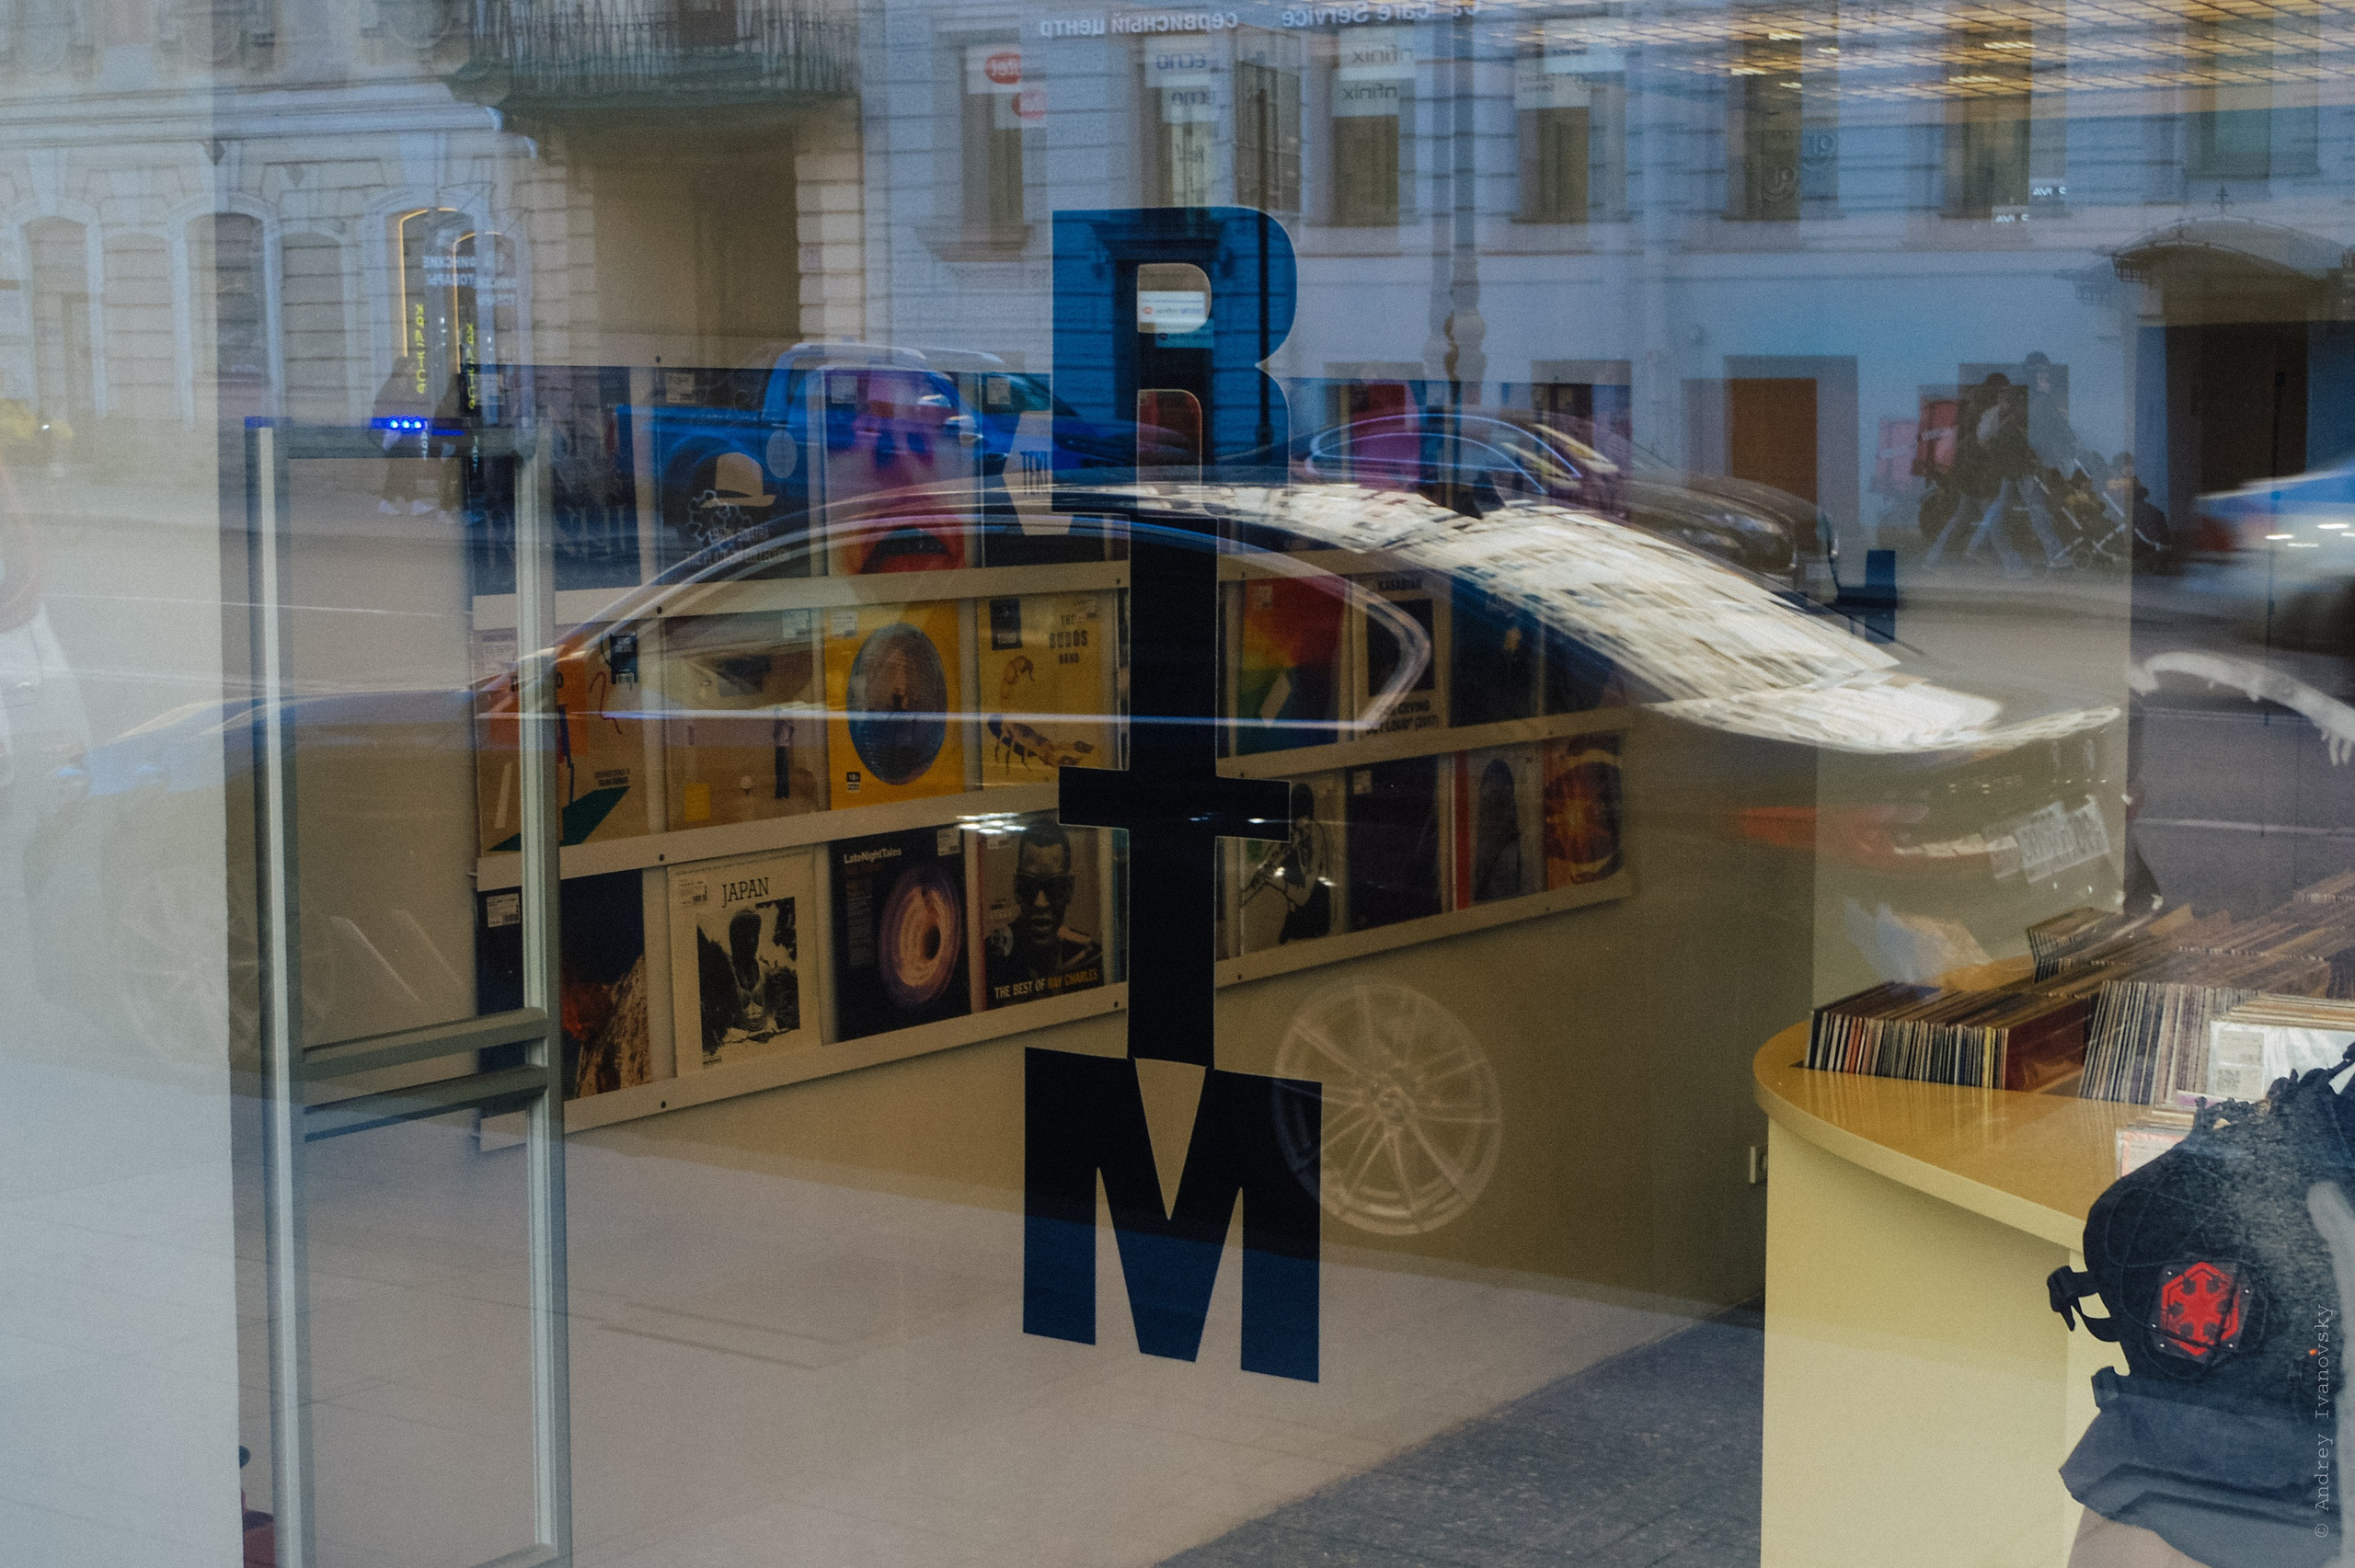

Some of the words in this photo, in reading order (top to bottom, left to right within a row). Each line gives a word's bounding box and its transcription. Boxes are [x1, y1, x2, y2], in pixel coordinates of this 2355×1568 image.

[844, 848, 902, 864] LateNightTales
[722, 876, 769, 907] JAPAN
[994, 986, 1010, 999] THE
[1013, 981, 1032, 995] BEST
[1035, 979, 1046, 991] OF
[1064, 968, 1097, 985] CHARLES
